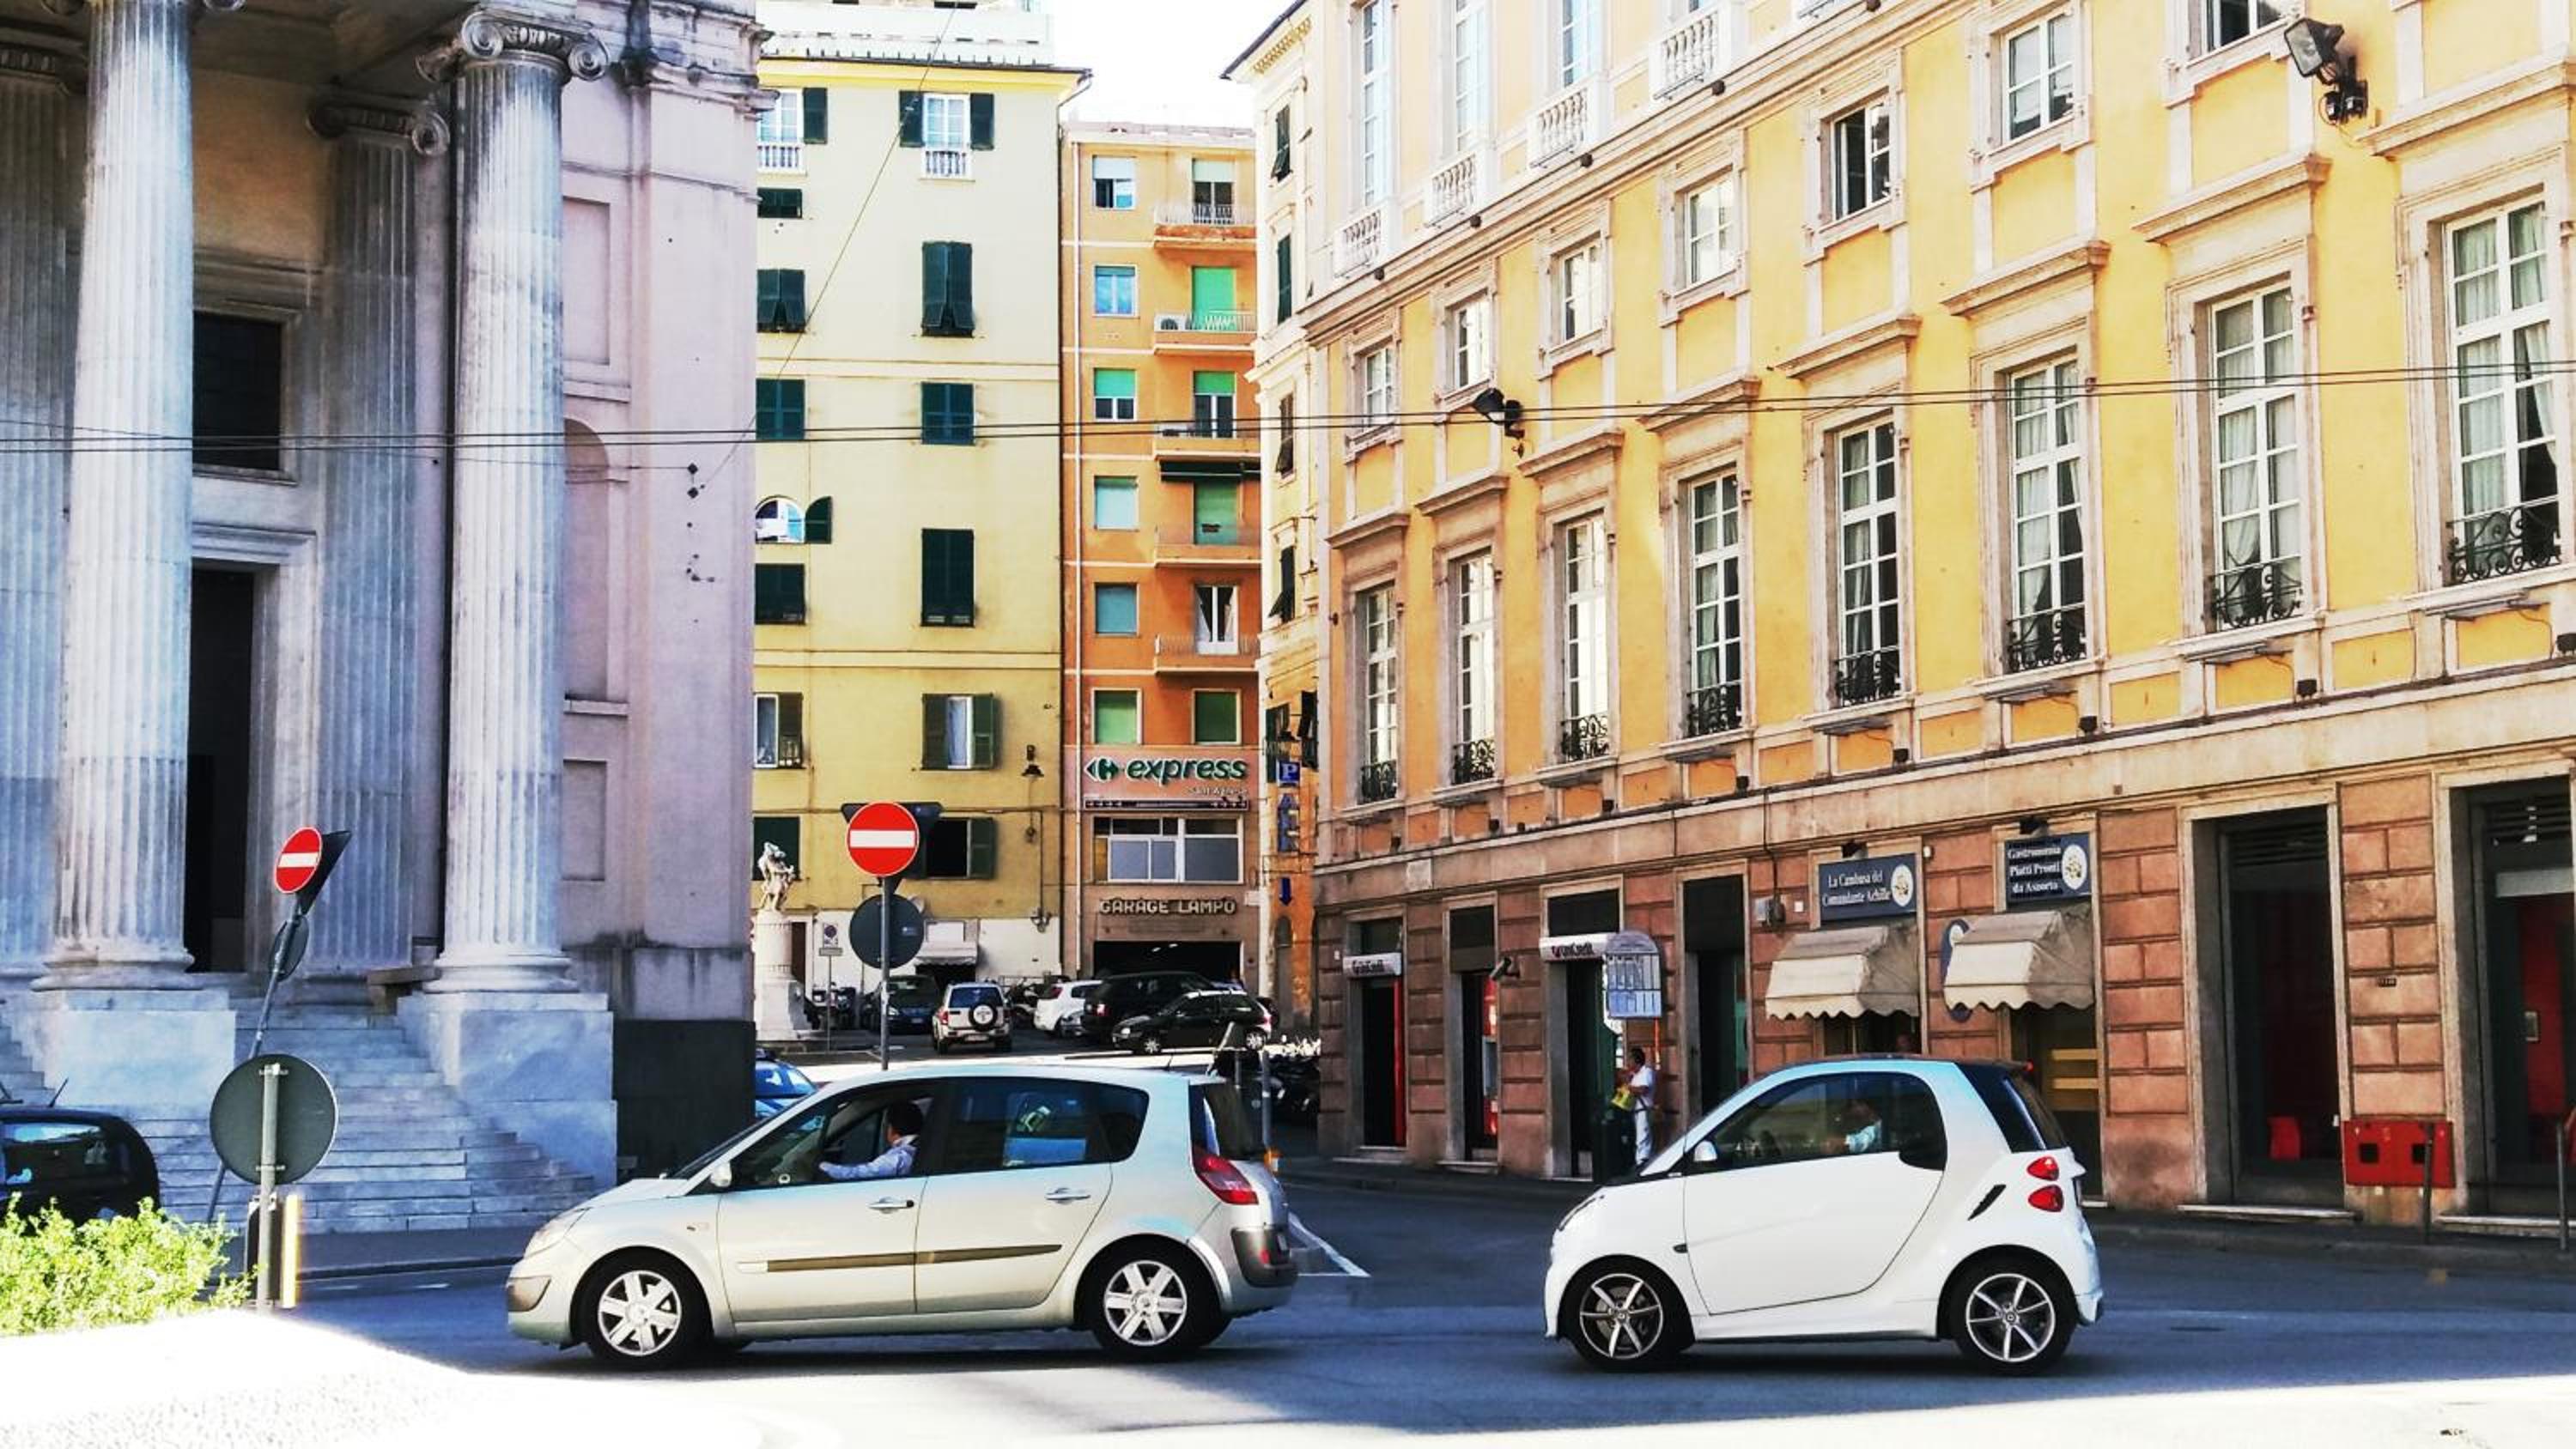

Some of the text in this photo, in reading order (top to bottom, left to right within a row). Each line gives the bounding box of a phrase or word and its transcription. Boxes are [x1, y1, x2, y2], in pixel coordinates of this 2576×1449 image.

[1126, 757, 1249, 787] express
[1282, 763, 1297, 779] P
[1828, 874, 1838, 888] La
[1099, 899, 1236, 914] GARAGE LAMPO
